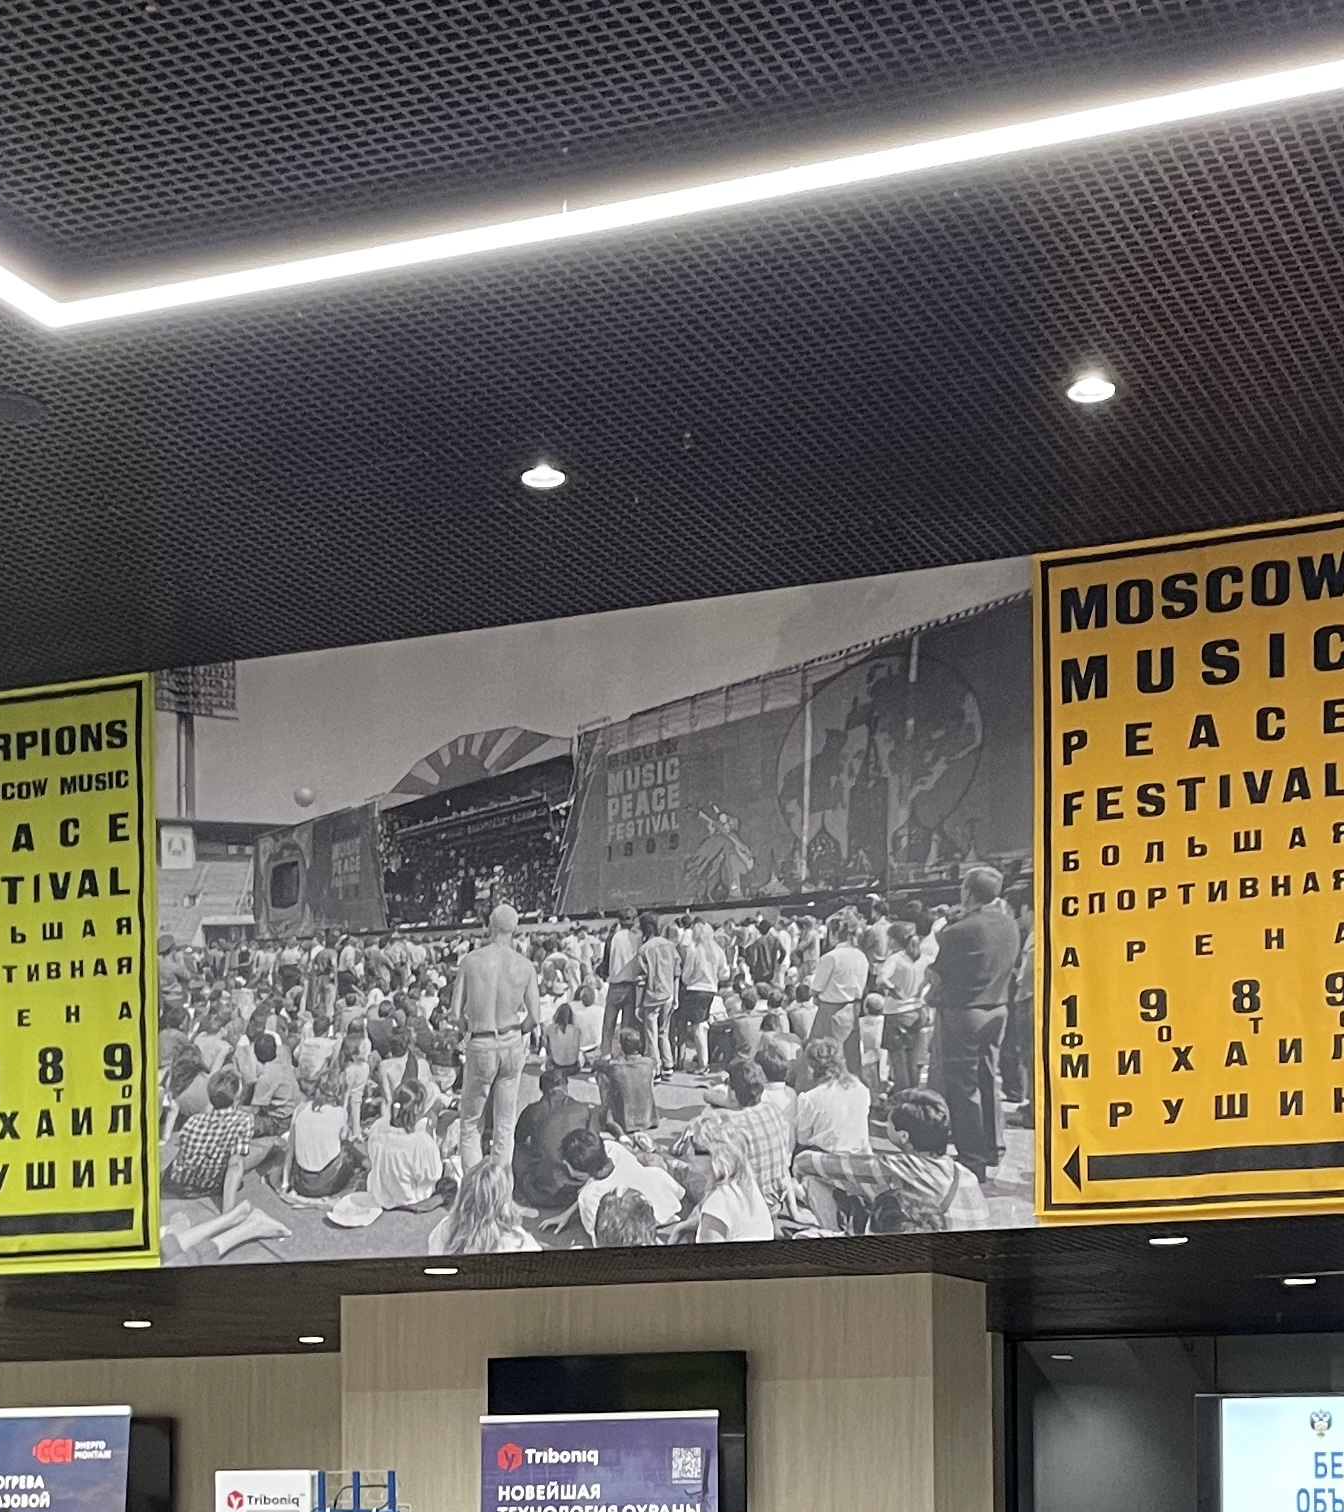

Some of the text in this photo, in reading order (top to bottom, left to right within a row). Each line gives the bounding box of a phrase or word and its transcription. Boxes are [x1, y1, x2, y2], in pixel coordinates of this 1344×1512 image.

[59, 769, 130, 797] MUSIC
[607, 756, 681, 797] MUSIC
[607, 782, 681, 823] PEACE
[607, 811, 680, 844] FESTIVAL
[524, 1447, 599, 1467] Triboniq
[246, 1494, 300, 1508] Triboniq
[497, 1481, 602, 1502] НОВЕЙШАЯ
